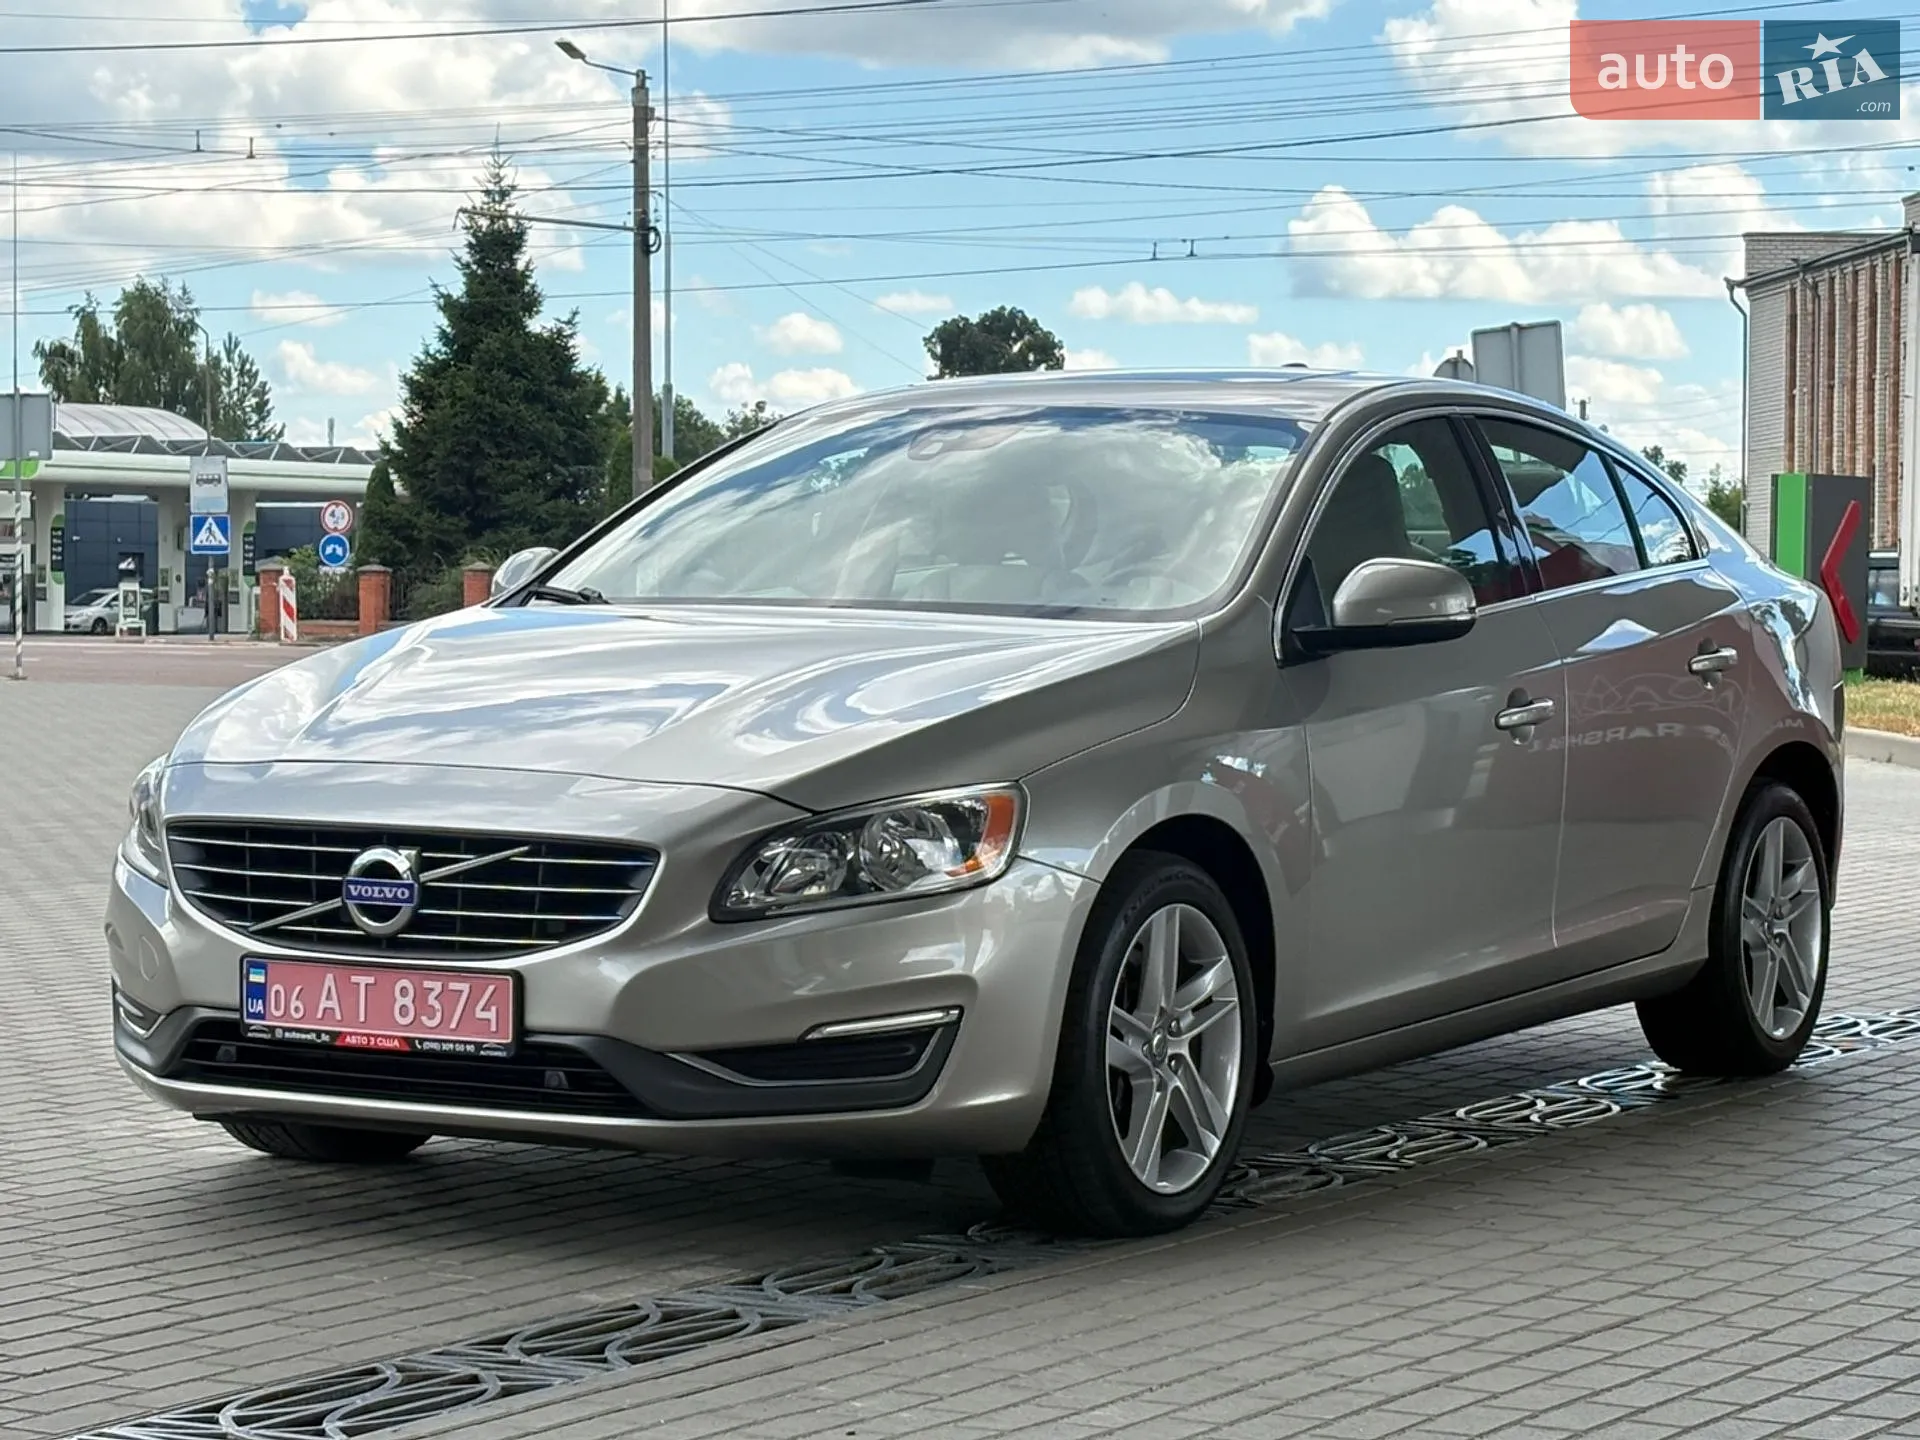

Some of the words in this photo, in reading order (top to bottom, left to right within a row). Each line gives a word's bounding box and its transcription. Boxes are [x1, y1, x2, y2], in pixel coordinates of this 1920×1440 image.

[348, 884, 410, 899] VOLVO
[247, 998, 264, 1015] UA
[270, 984, 305, 1019] 06
[316, 973, 376, 1023] AT
[393, 979, 498, 1033] 8374
[376, 1037, 400, 1048] США
